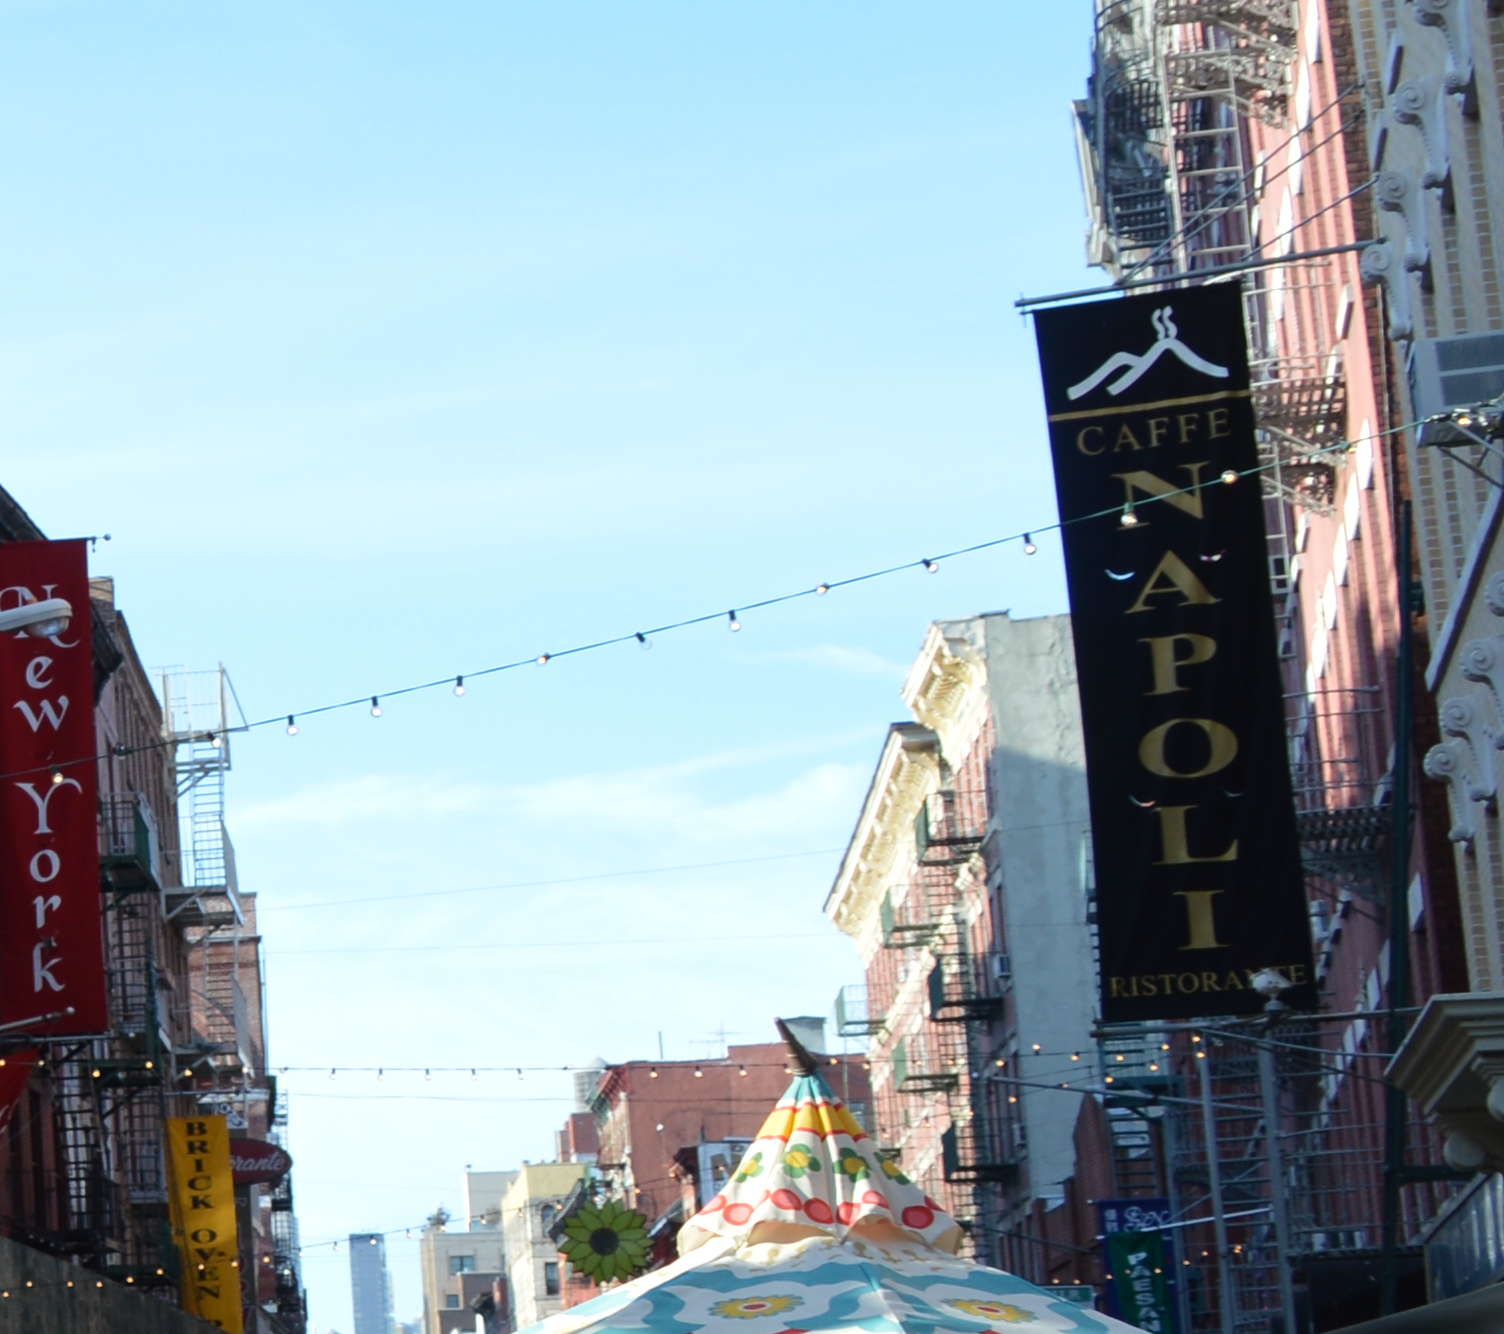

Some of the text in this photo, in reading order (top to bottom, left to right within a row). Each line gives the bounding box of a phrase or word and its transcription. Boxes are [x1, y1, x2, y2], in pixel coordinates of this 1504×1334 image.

[1076, 407, 1233, 457] CAFFE
[1110, 461, 1240, 952] NAPOLI
[13, 776, 84, 994] York
[1109, 963, 1309, 1001] RISTORAE
[185, 1121, 215, 1211] BRICK
